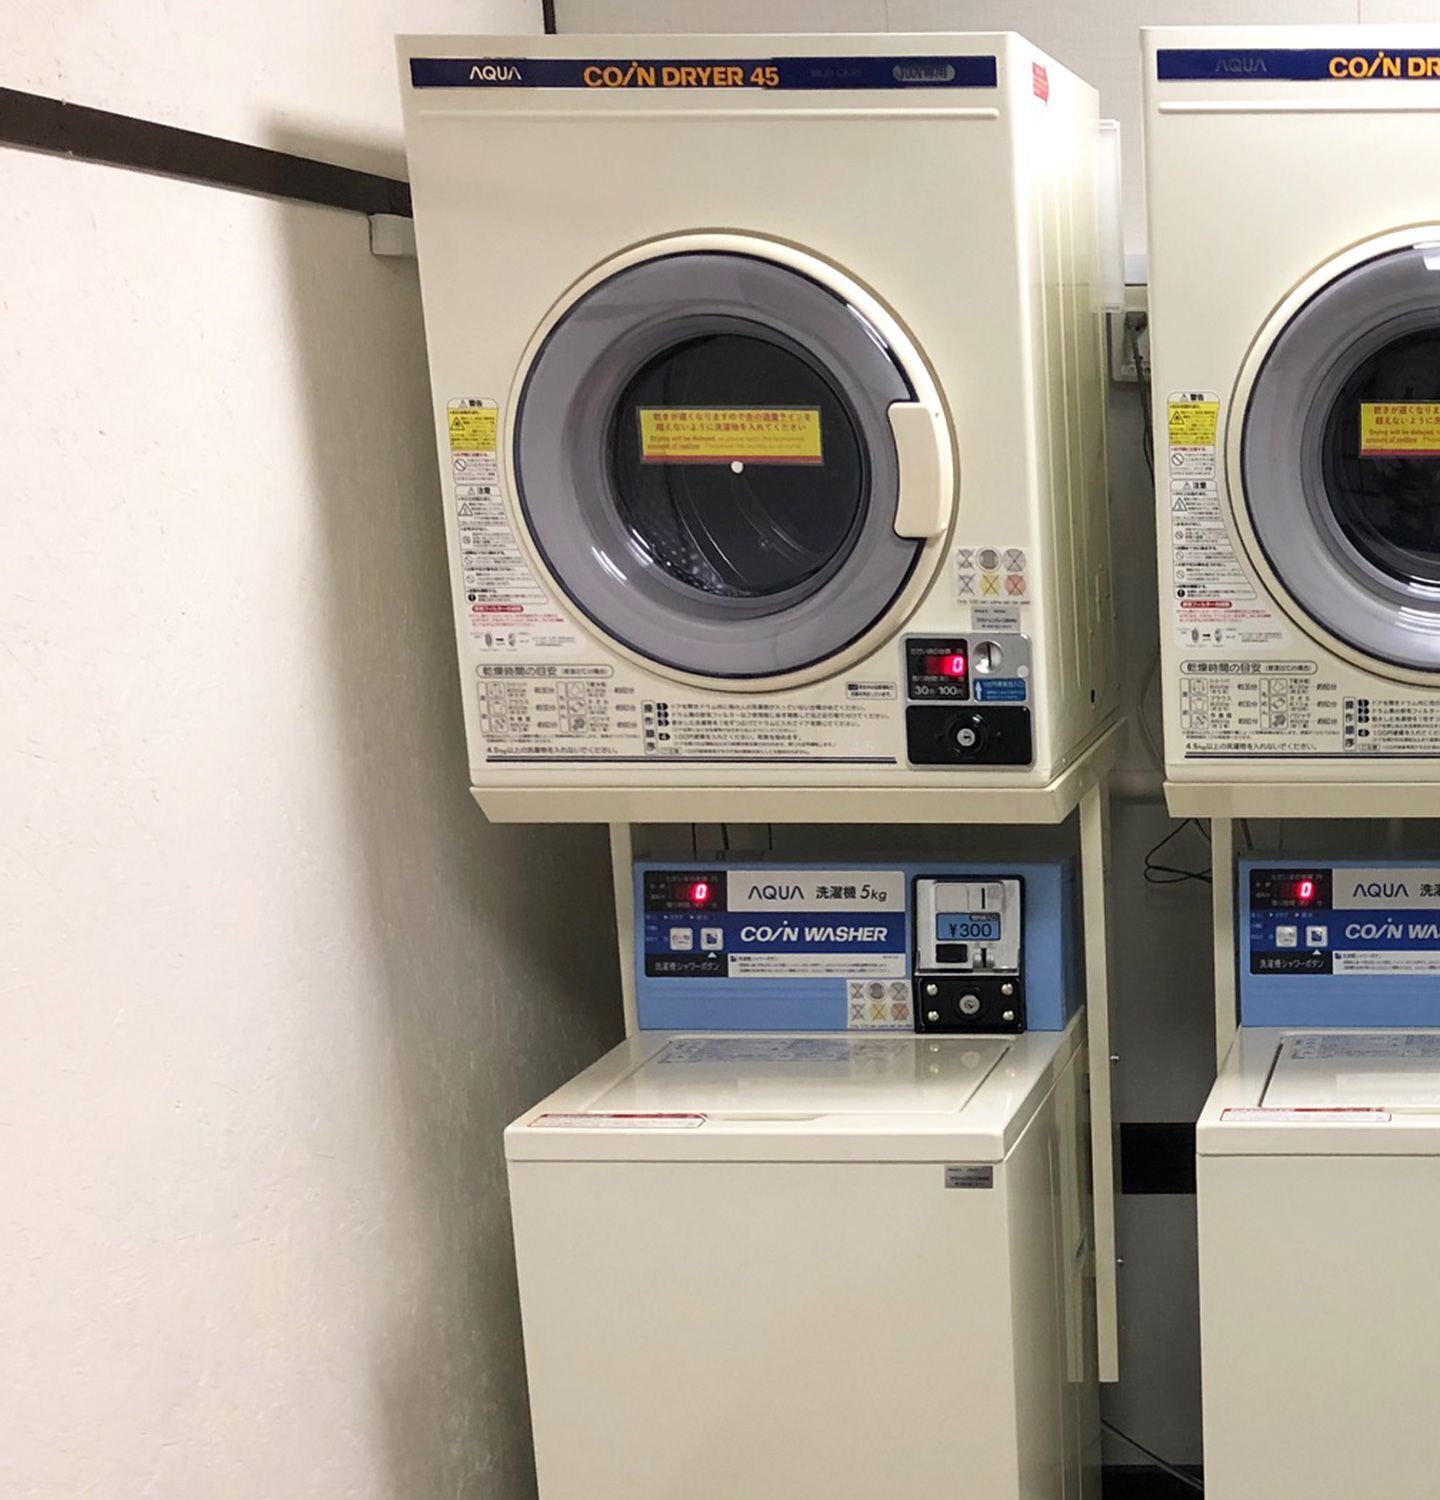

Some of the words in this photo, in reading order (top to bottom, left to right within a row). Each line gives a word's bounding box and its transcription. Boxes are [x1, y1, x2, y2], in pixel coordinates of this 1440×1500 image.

[1216, 58, 1267, 73] AQUA
[469, 66, 521, 81] AQUA
[662, 67, 743, 86] DRYER
[750, 67, 779, 86] 45
[483, 667, 558, 677] 乾燥時間の目安
[952, 656, 963, 673] 0
[1187, 663, 1261, 673] 乾燥時間の目安
[695, 884, 707, 900] 0
[748, 885, 804, 900] AQUA
[816, 886, 856, 899] 洗濯機
[860, 884, 887, 901] 5kg
[1300, 882, 1312, 898] 0
[1353, 883, 1409, 897] AQUA
[805, 927, 888, 942] WASHER
[949, 923, 992, 938] ¥300
